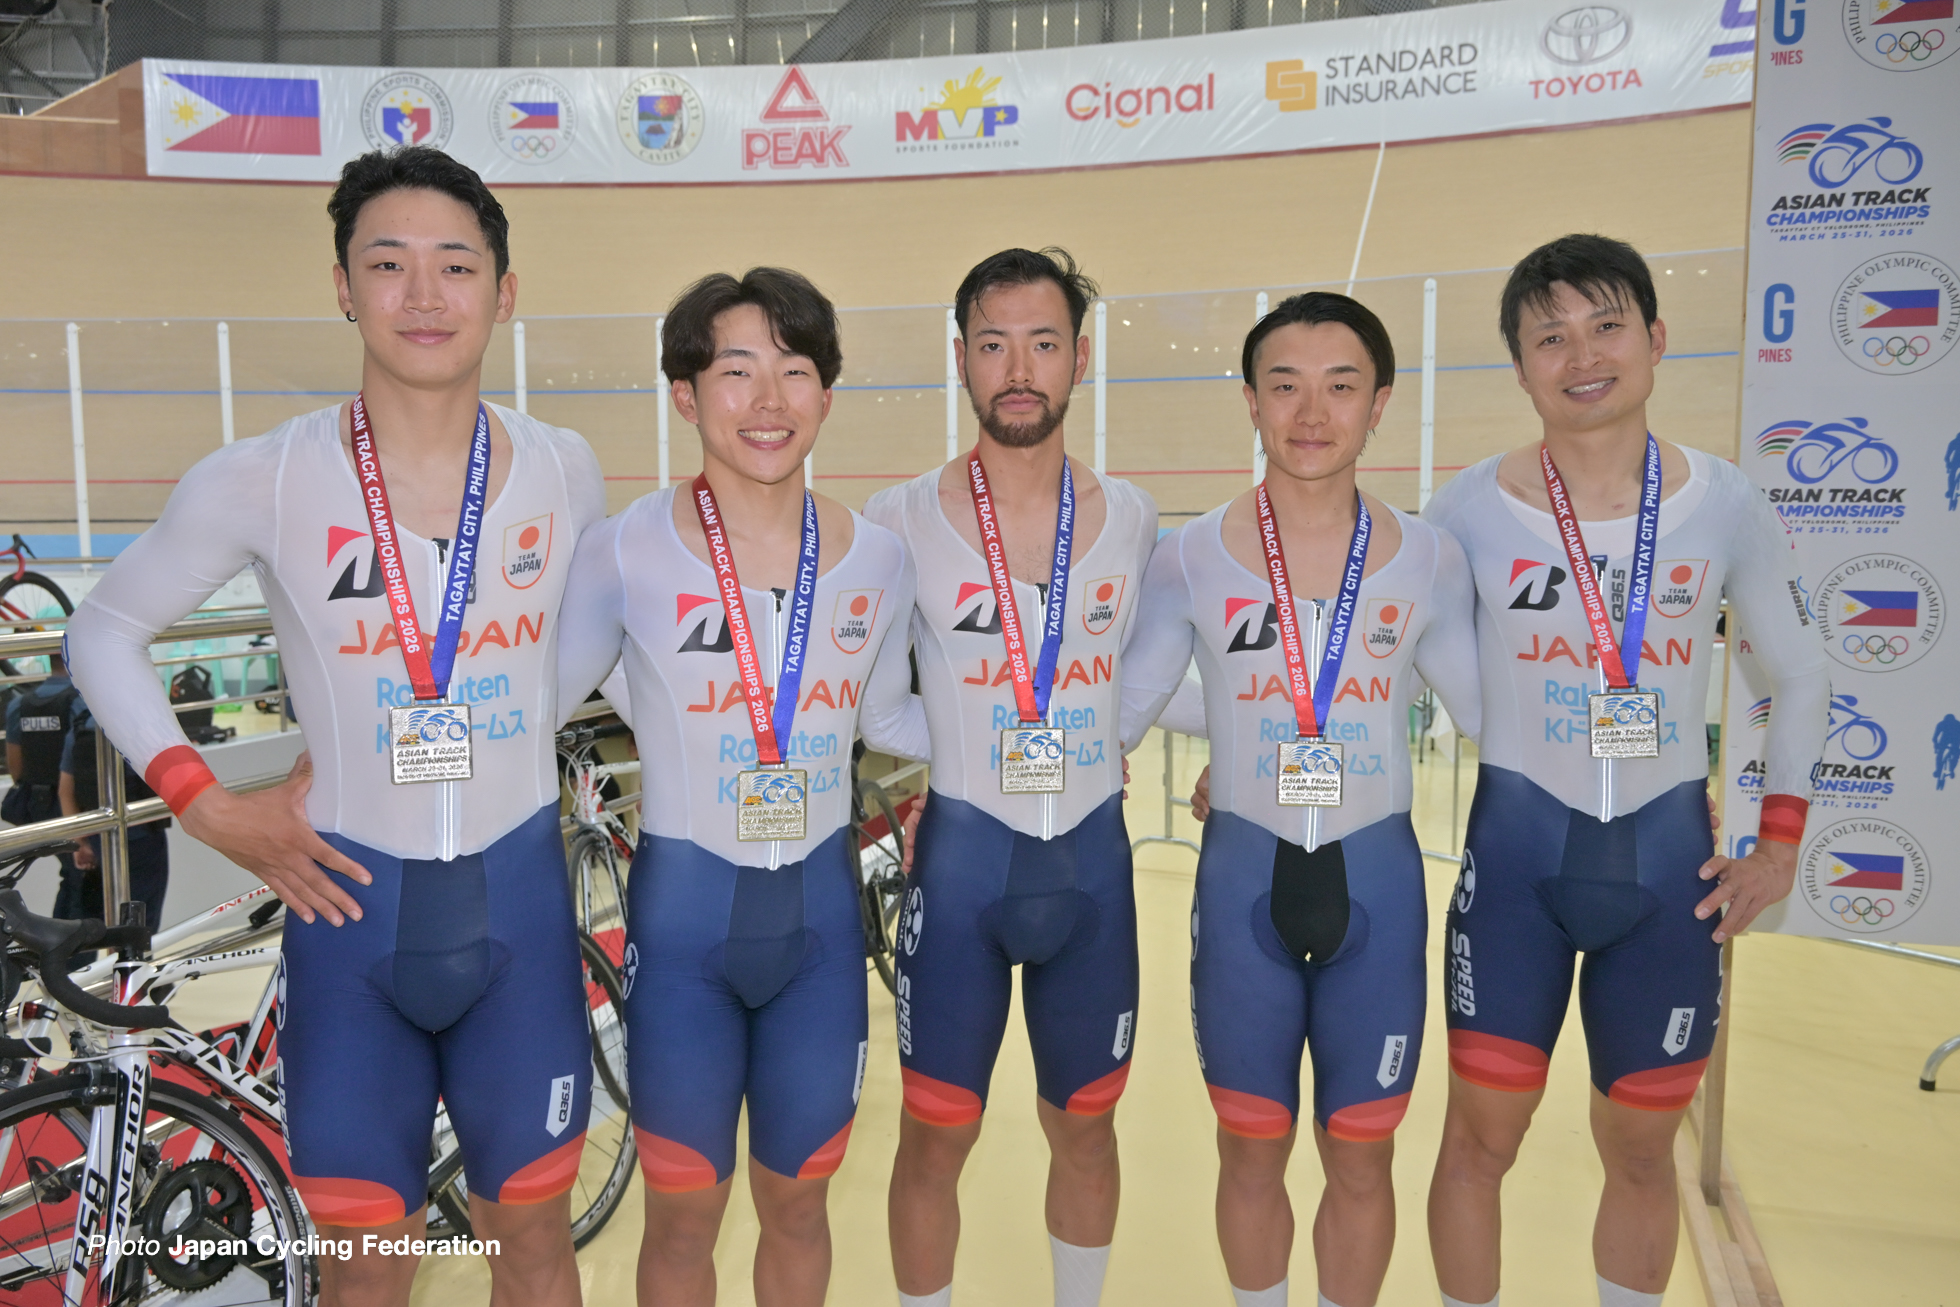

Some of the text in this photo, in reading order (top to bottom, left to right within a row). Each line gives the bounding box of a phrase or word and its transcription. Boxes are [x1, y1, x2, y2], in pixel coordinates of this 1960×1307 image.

[1325, 43, 1478, 79] STANDARD
[1702, 59, 1755, 79] SPOR
[508, 77, 551, 93] OLYMPIC
[621, 76, 700, 122] TAGAYTAY CITY
[1065, 73, 1215, 128] Cignal
[1325, 70, 1478, 107] INSURANCE
[1528, 68, 1643, 100] TOYOTA
[365, 76, 450, 141] PHILIPPINE SPORTS COMMISSION
[895, 105, 1019, 142] MVP
[639, 150, 682, 162] CAVITE
[741, 125, 852, 170] PEAK
[945, 140, 1020, 151] FOUNDATION
[1766, 205, 1931, 226] CHAMPIONSHIPS
[1770, 187, 1932, 212] ASIAN TRACK
[1779, 228, 1913, 242] MARCH 25-31, 2026
[1763, 283, 1795, 344] G
[1836, 257, 1960, 346] PHILIPPINE OLYMPIC COMMITTEE
[1758, 348, 1792, 363] PINES
[469, 413, 487, 496] PHILIPPINES
[1768, 488, 1907, 503] SIAN TRACK
[1776, 505, 1906, 518] AMPIONSHIPS
[352, 394, 420, 653] ASIAN TRACK CHAMPIONSHIPS 2026
[463, 500, 483, 537] CITY,
[1631, 440, 1659, 613] TAGAYTAY CITY, PHILIPPINES
[1809, 526, 1849, 534] 25-31,
[1855, 526, 1889, 534] 2026
[509, 558, 541, 575] JAPAN
[518, 552, 536, 562] TEAM
[1048, 459, 1073, 637] TAGAYTAY CITY, PHILIPPINES
[1542, 448, 1613, 653] ASIAN TRACK CHAMPIONSHIPS 2026
[445, 540, 474, 622] TAGAYTAY
[970, 460, 1027, 683] ASIAN TRACK CHAMPIONSHIPS 2026
[1258, 486, 1307, 696] ASIAN TRACK CHAMPIONSHIPS 2026
[1612, 569, 1625, 622] Q36.5
[1659, 595, 1693, 605] JAPAN
[1787, 580, 1810, 627] KEIRIN
[1817, 559, 1940, 645] PHILIPPINE OLYMPIC COMMITTEE
[698, 489, 769, 732] ASIAN TRACK CHAMPIONSHIPS 2026
[785, 597, 808, 674] TAGAYTAY
[800, 562, 815, 594] CITY,
[1088, 610, 1113, 622] JAPAN
[1326, 592, 1354, 662] TAGAYTAY
[1345, 562, 1363, 591] CITY,
[338, 611, 545, 658] JAAN
[838, 628, 867, 639] JAPAN
[1369, 634, 1397, 646] JAPAN
[1516, 634, 1692, 670] JAAN
[963, 654, 1112, 690] JAAN
[1236, 673, 1391, 703] JAAN
[686, 679, 861, 713] JAAN
[21, 716, 60, 731] PULIS
[1820, 763, 1895, 780] TRACK
[1809, 800, 1878, 809] 5-31, 2026
[1805, 823, 1925, 908] PHILIPPINE OLYMPIC COMMITTEE
[176, 948, 265, 967] ANCHOR
[1452, 927, 1476, 1017] SPEED
[897, 967, 912, 1056] SPEED
[1675, 1011, 1691, 1045] Q36.5
[1389, 1040, 1404, 1077] Q36.5
[558, 1081, 570, 1123] Q36.5
[116, 1063, 145, 1246] ANCHOR
